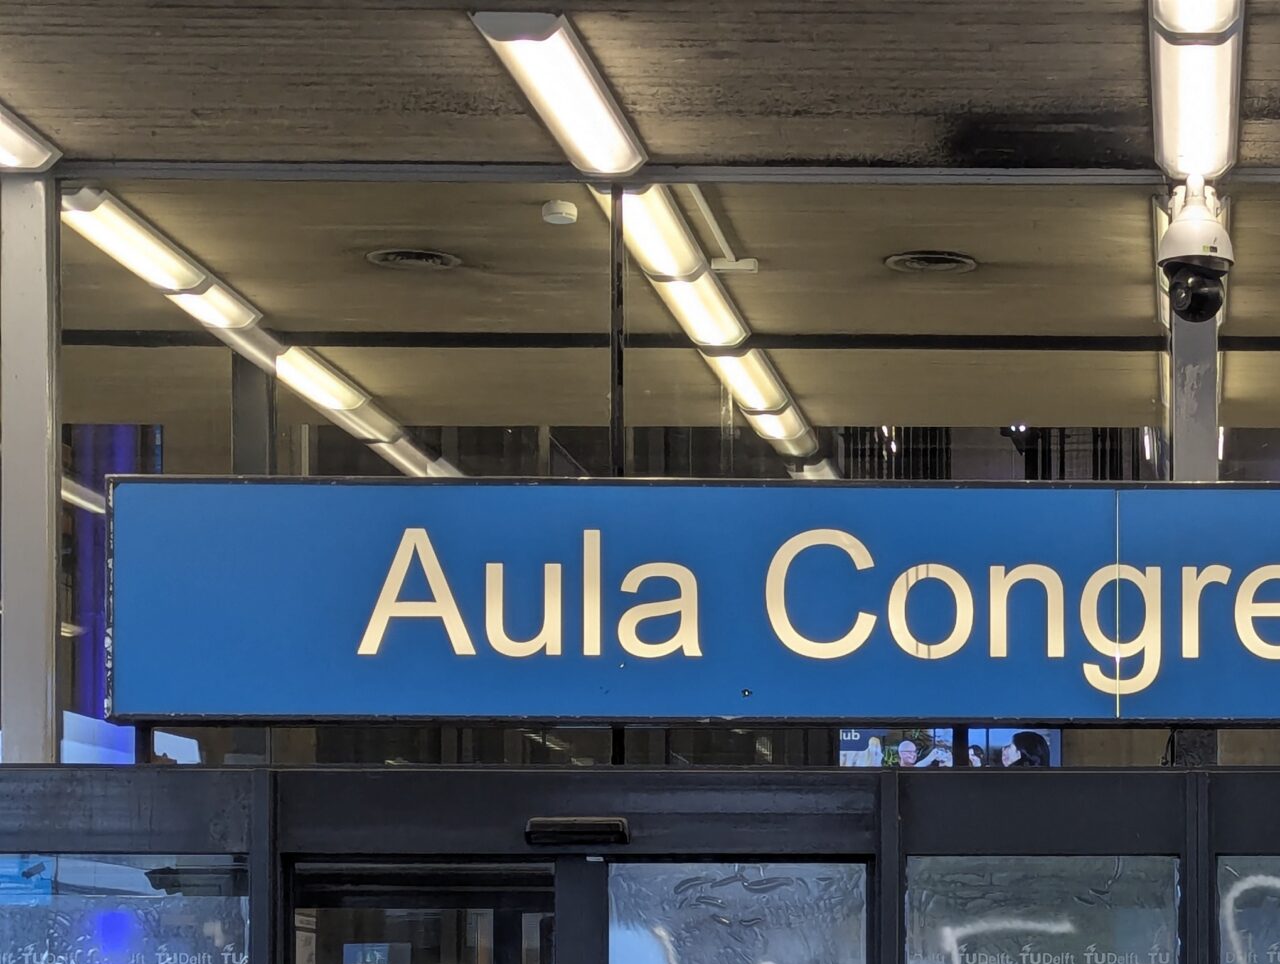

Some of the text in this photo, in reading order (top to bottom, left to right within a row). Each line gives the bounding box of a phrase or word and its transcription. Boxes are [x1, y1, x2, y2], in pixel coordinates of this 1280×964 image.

[357, 527, 703, 659] Aula
[1019, 952, 1075, 964] TUDelft
[1084, 952, 1139, 964] TUDelft
